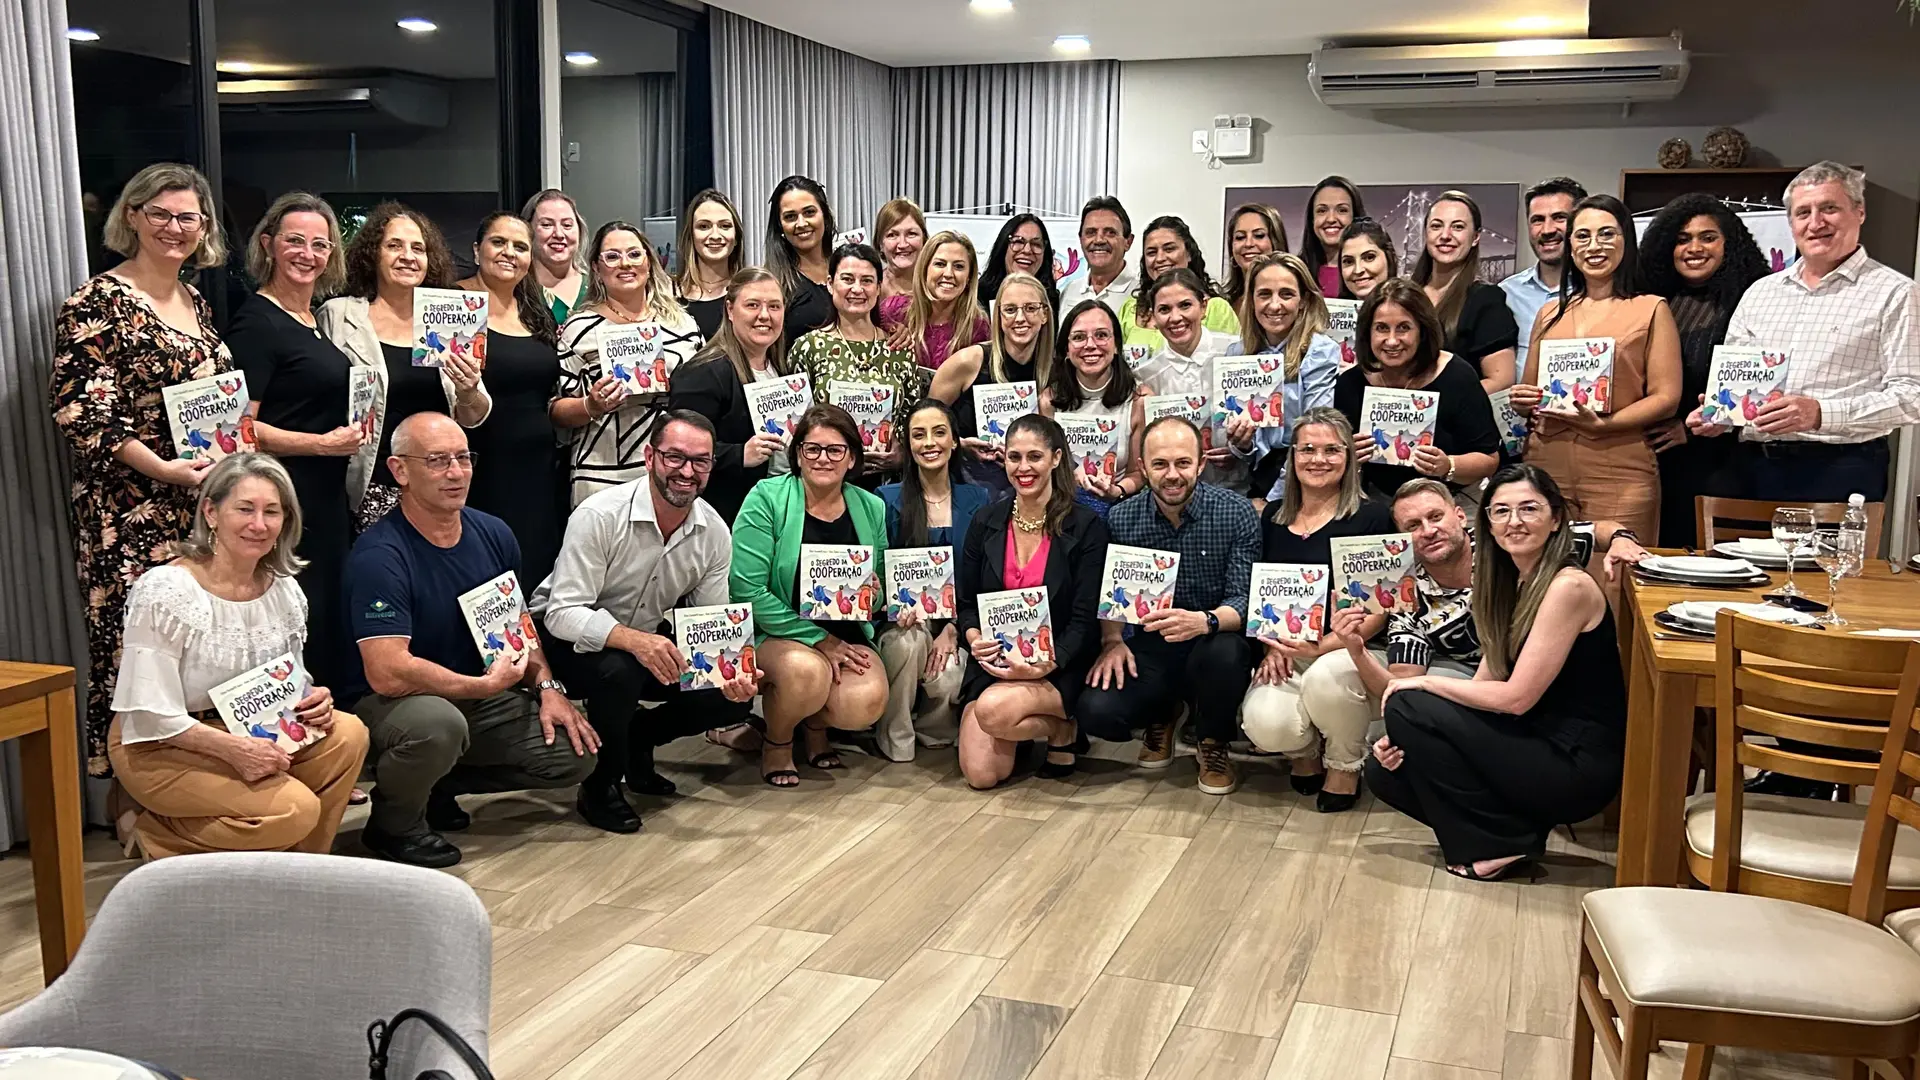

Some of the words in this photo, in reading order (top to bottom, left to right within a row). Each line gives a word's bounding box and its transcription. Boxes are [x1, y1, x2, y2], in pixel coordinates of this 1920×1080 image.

[430, 304, 454, 312] SEGREDO
[423, 312, 476, 326] COOPERAÇÃO
[611, 337, 632, 346] SEGREDO
[607, 342, 653, 358] COOPERAÇÃO
[1554, 352, 1577, 361] SEGREDO
[1548, 358, 1599, 373] COOPERAÇÃO
[1726, 361, 1751, 369] SEGREDO
[1228, 369, 1250, 377] SEGREDO
[1718, 370, 1774, 383] COOPERAÇÃO
[1222, 375, 1272, 389] COOPERAÇÃO
[183, 394, 210, 409] SEGREDO
[760, 391, 782, 402] SEGREDO
[987, 395, 1008, 404] SEGREDO
[757, 394, 803, 414] COOPERAÇÃO
[983, 400, 1028, 414] COOPERAÇÃO
[1378, 402, 1402, 410] SEGREDO
[179, 398, 238, 424] COOPERAÇÃO
[1158, 407, 1179, 415] SEGREDO
[1370, 411, 1424, 424] COOPERAÇÃO
[816, 558, 840, 567] SEGREDO
[1348, 551, 1375, 561] SEGREDO
[899, 561, 921, 570] SEGREDO
[1342, 557, 1401, 574] COOPERAÇÃO
[810, 566, 861, 579] COOPERAÇÃO
[894, 567, 943, 582] COOPERAÇÃO
[1112, 568, 1164, 584] COOPERAÇÃO
[1267, 577, 1291, 585] SEGREDO
[1259, 585, 1314, 598] COOPERAÇÃO
[476, 598, 495, 614] SEGREDO
[476, 597, 516, 628] COOPERAÇÃO
[993, 604, 1015, 614] SEGREDO
[988, 608, 1038, 627] COOPERAÇÃO
[692, 620, 717, 632] SEGREDO
[686, 626, 742, 645] COOPERAÇÃO
[235, 685, 264, 706] SEGREDO
[264, 681, 273, 690] DA
[233, 682, 295, 722] COOPERAÇÃO
